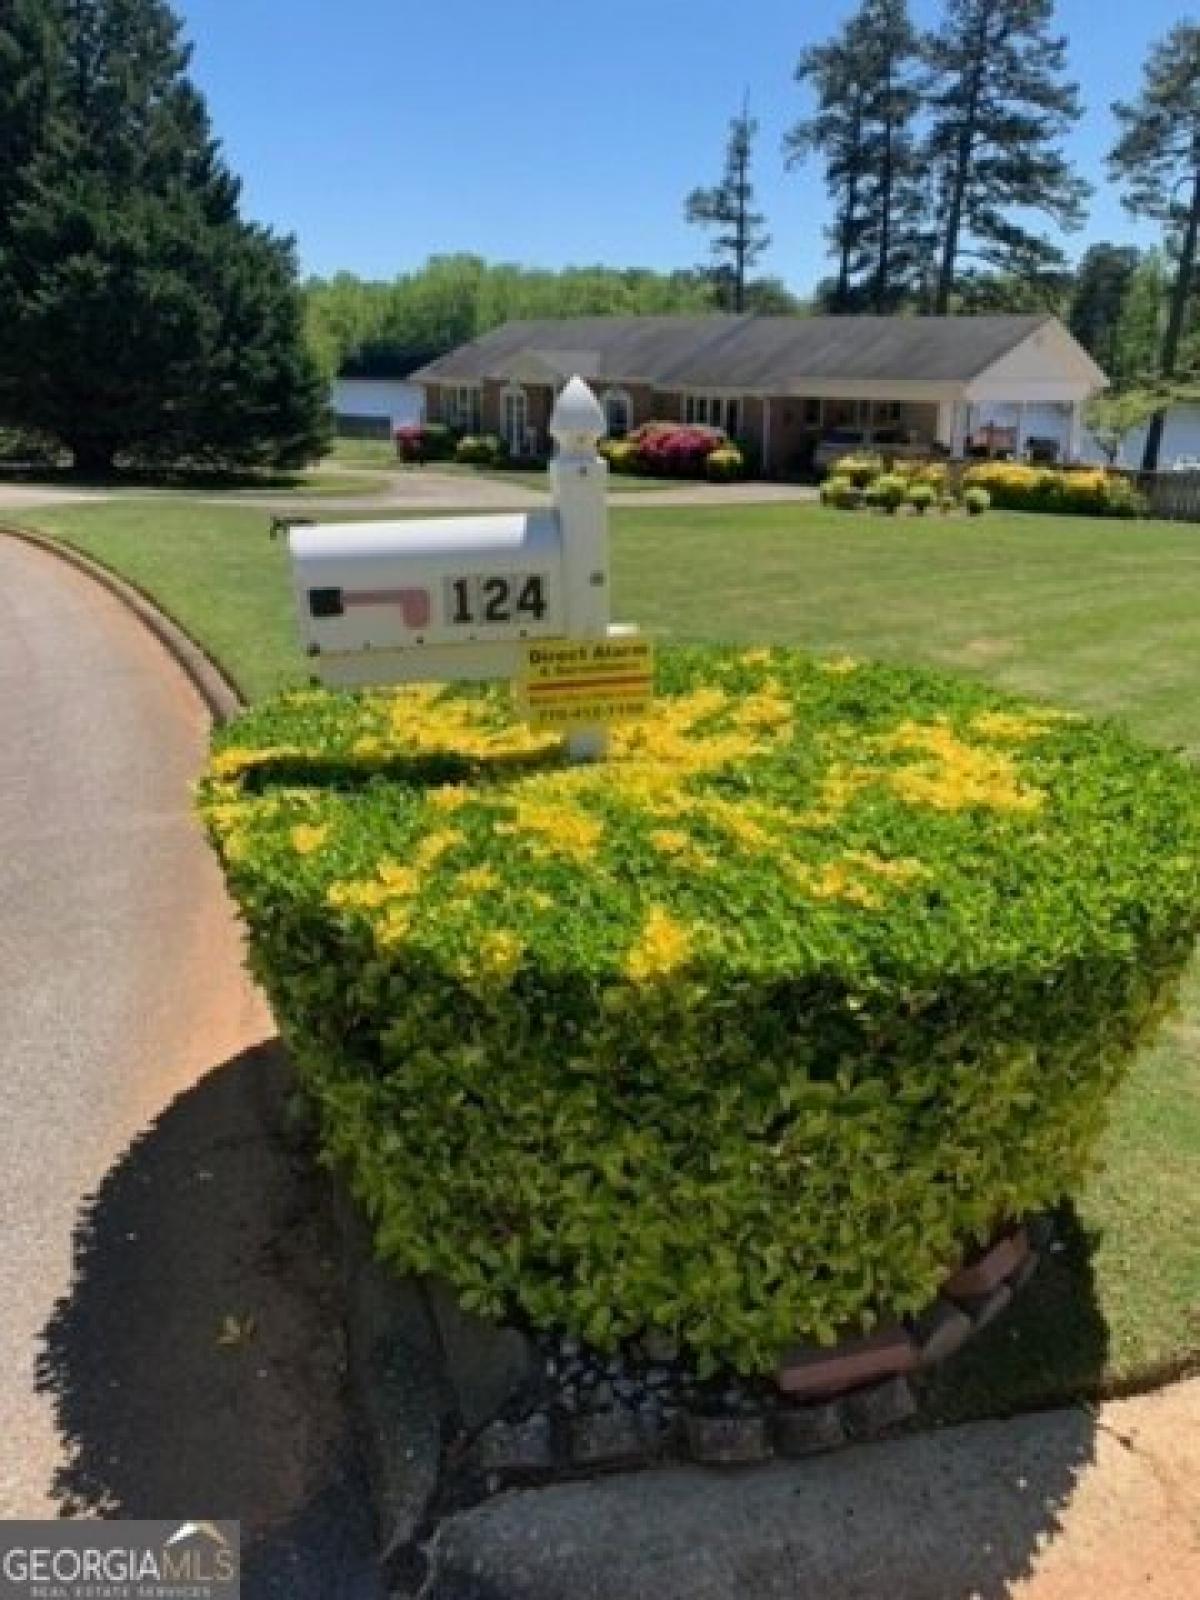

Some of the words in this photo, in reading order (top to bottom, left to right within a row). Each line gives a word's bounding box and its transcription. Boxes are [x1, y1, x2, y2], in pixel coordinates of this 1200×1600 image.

[452, 576, 547, 624] 124
[529, 647, 587, 665] Direct
[592, 642, 648, 659] Alarm
